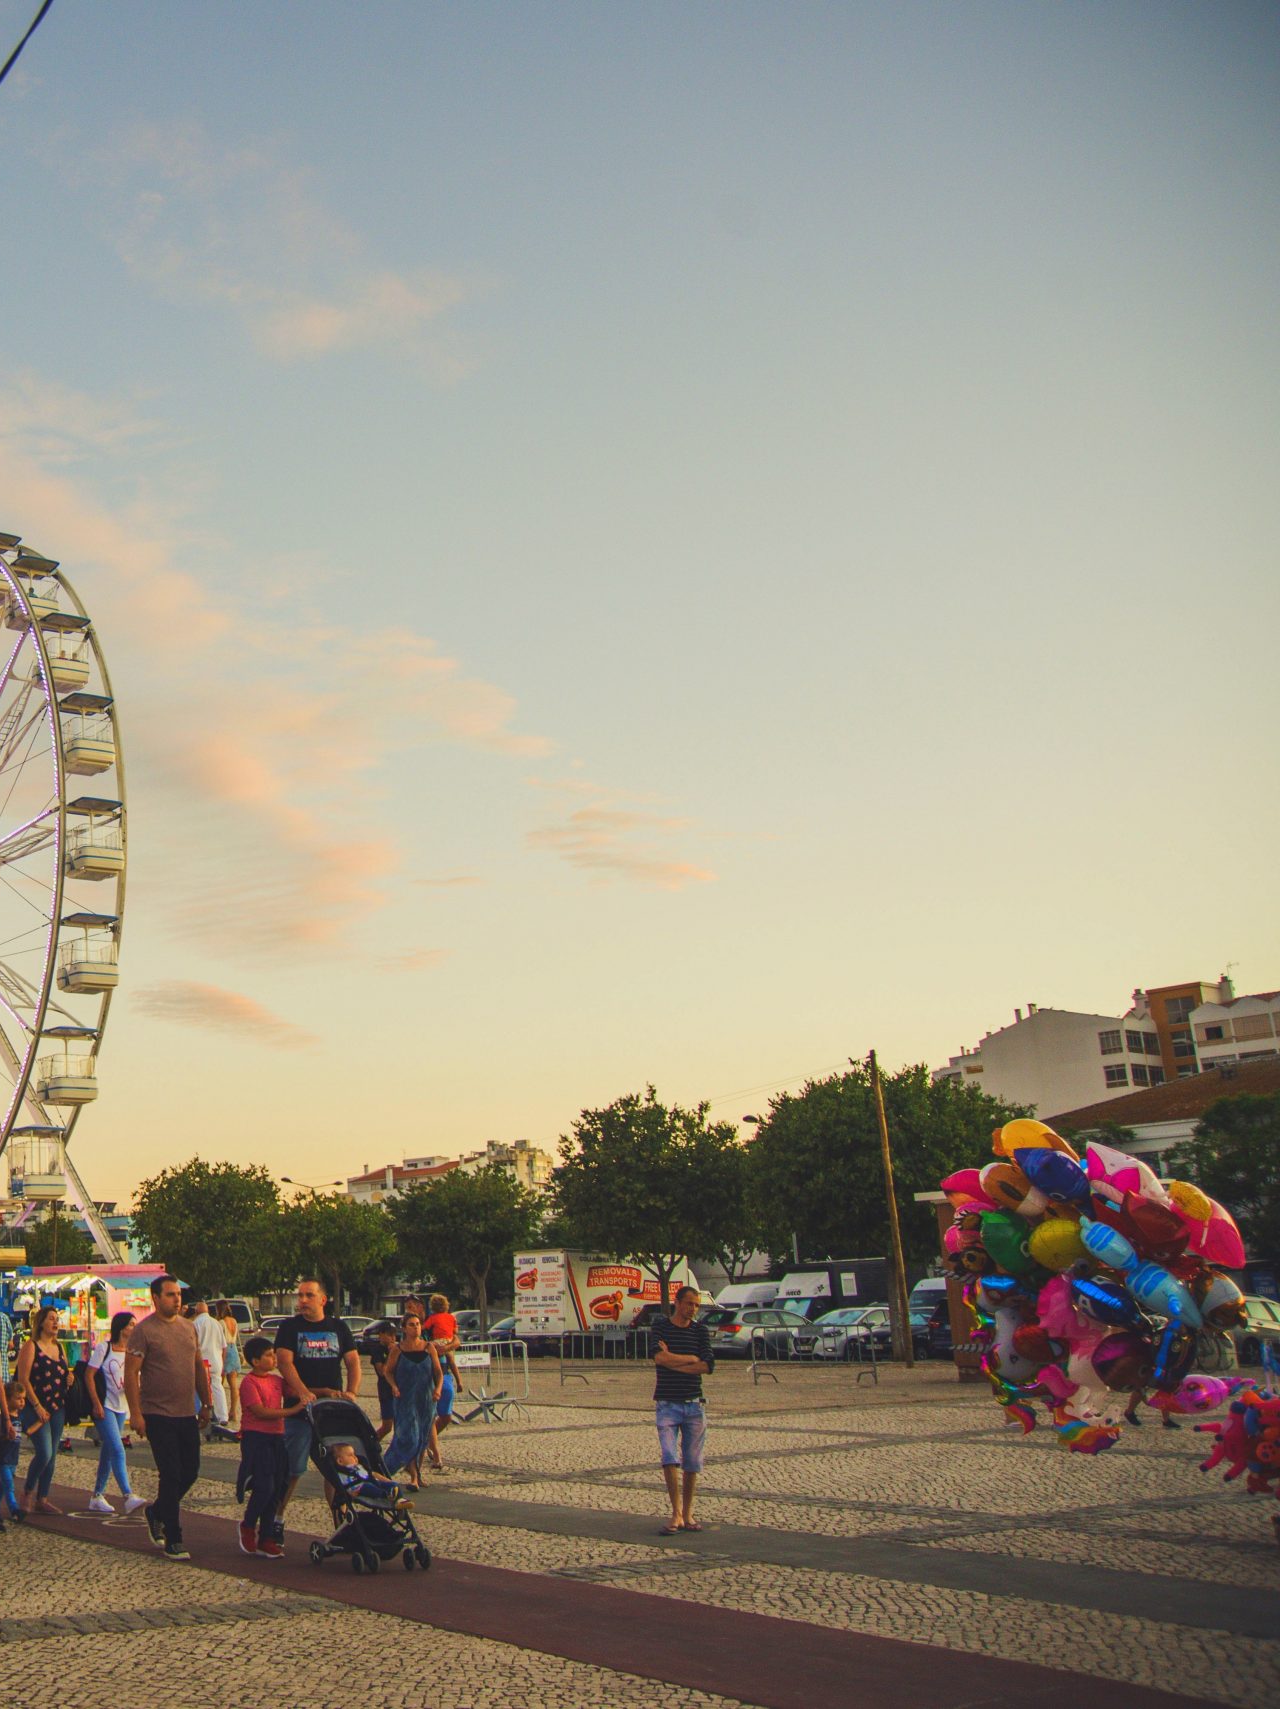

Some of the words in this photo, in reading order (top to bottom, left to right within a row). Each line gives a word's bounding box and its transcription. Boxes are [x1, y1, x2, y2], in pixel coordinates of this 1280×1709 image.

[592, 1267, 638, 1277] REMOVALS
[590, 1277, 638, 1288] TRANSPORTS
[644, 1281, 658, 1293] FREE
